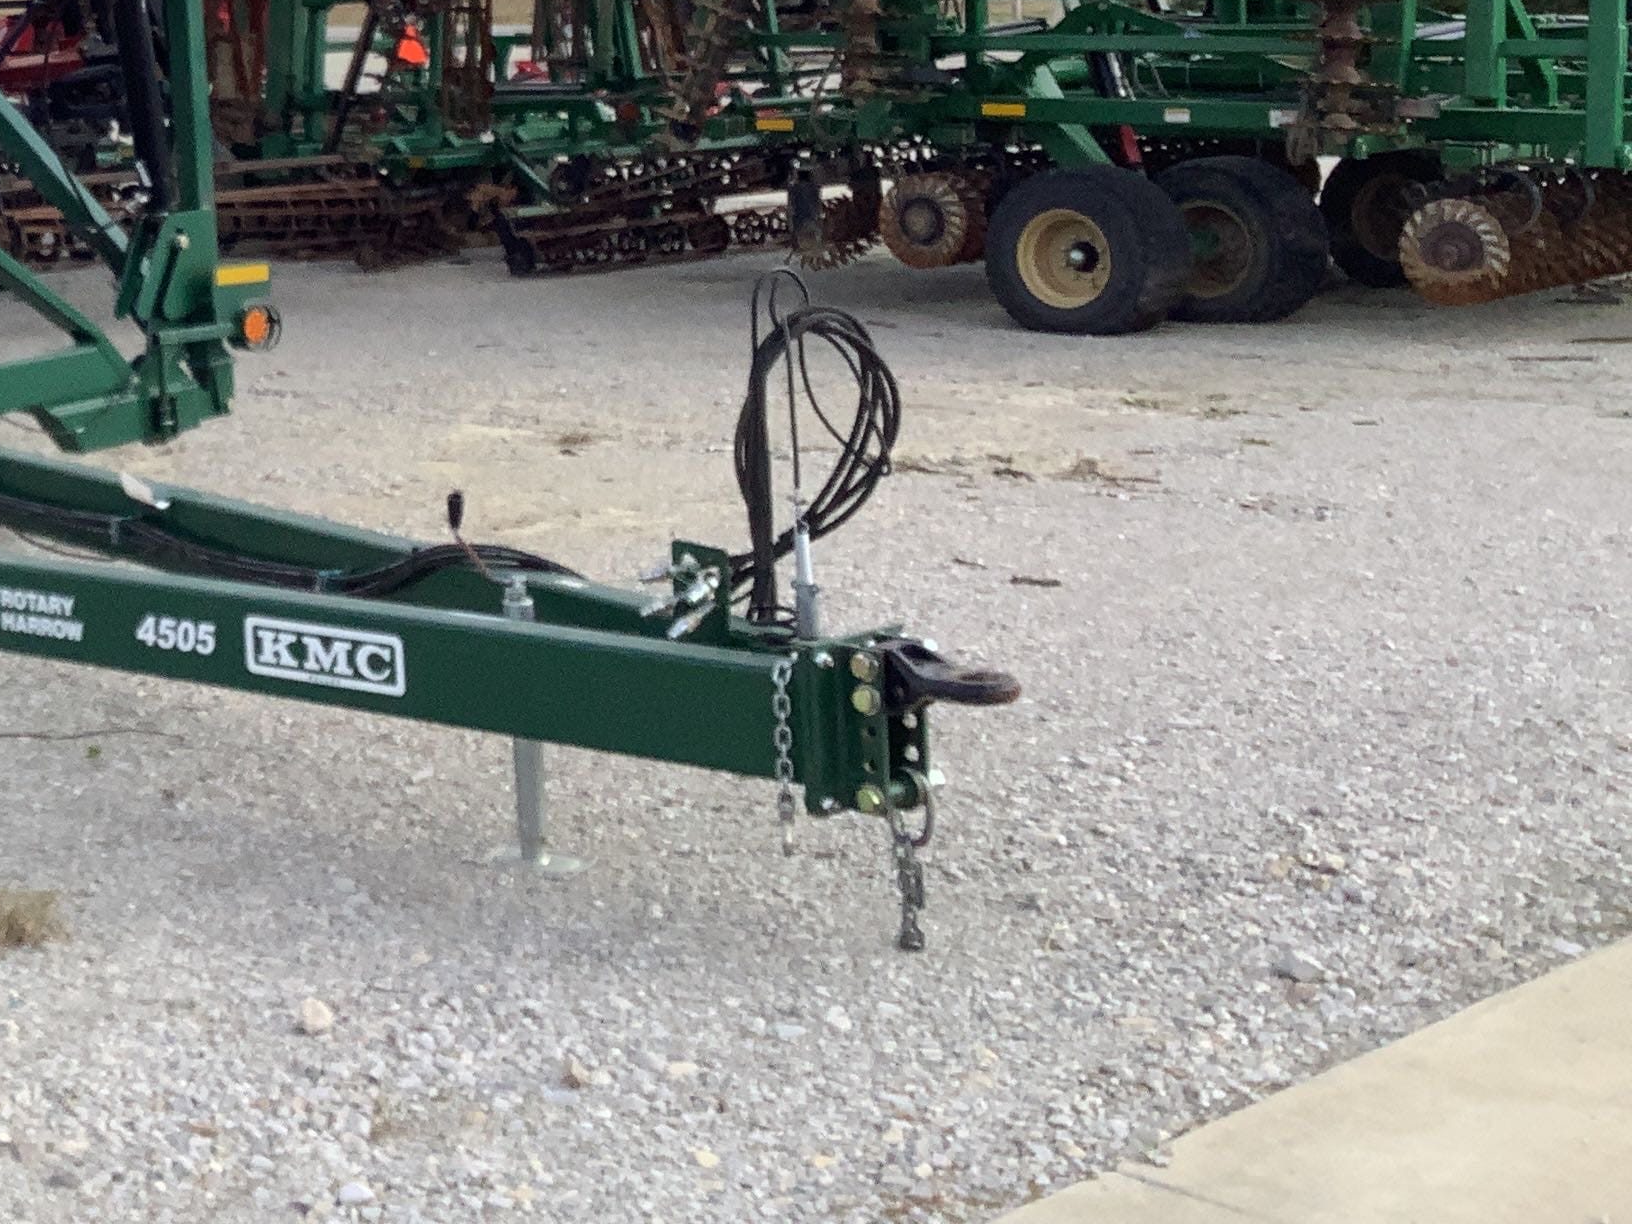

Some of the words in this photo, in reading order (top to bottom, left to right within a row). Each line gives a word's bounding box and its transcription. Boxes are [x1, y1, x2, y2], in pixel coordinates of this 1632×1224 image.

[0, 590, 75, 617] ROTARY
[0, 612, 84, 642] HARROW
[135, 615, 217, 655] 4505
[257, 629, 393, 682] KMC
